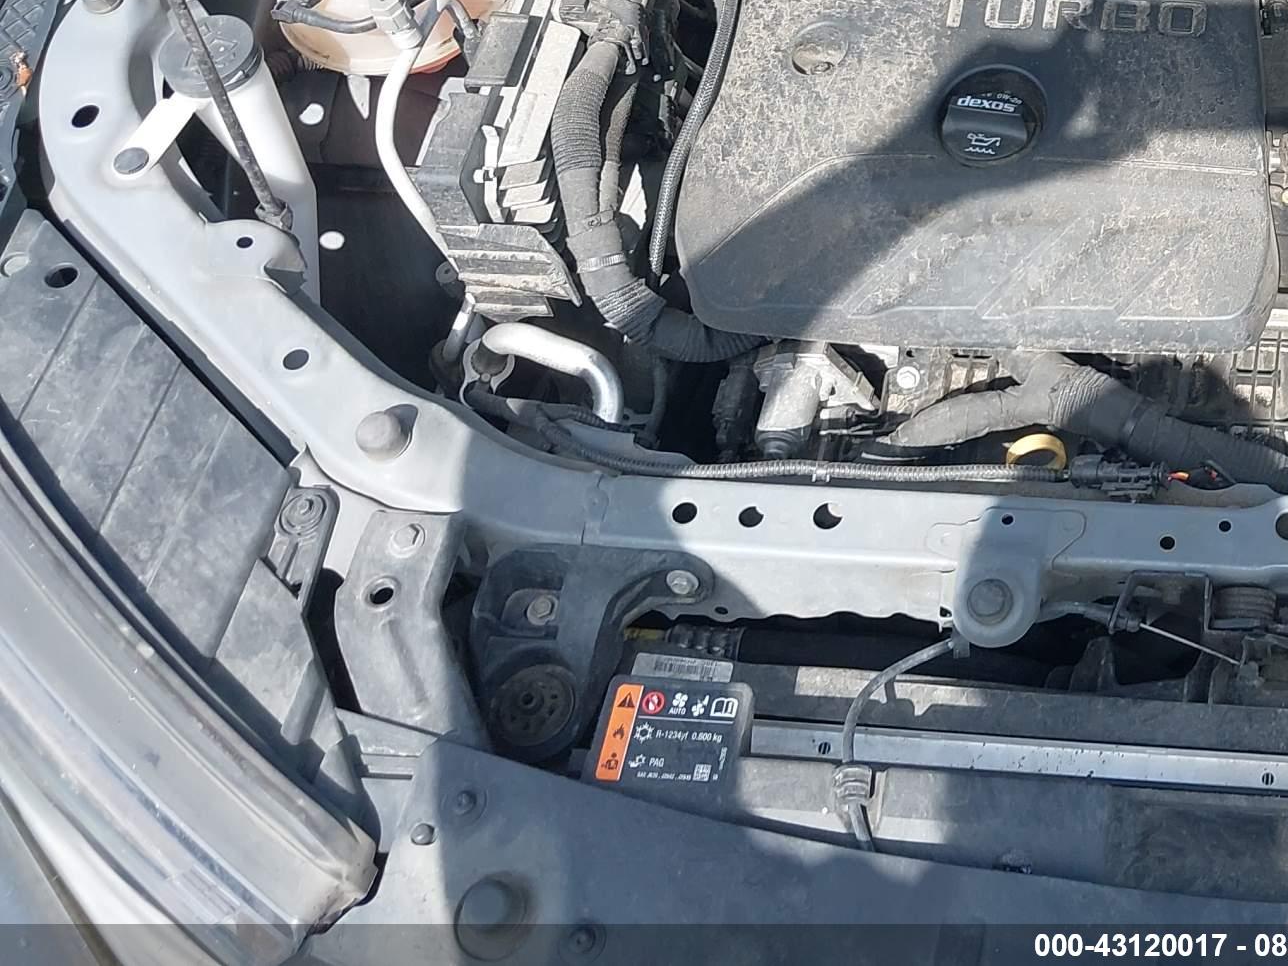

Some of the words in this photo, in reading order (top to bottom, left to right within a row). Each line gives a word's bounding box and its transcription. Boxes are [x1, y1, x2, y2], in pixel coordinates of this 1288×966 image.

[957, 95, 1017, 113] dexos
[667, 706, 687, 715] AUTO
[712, 732, 723, 744] kg
[649, 757, 665, 768] PAG
